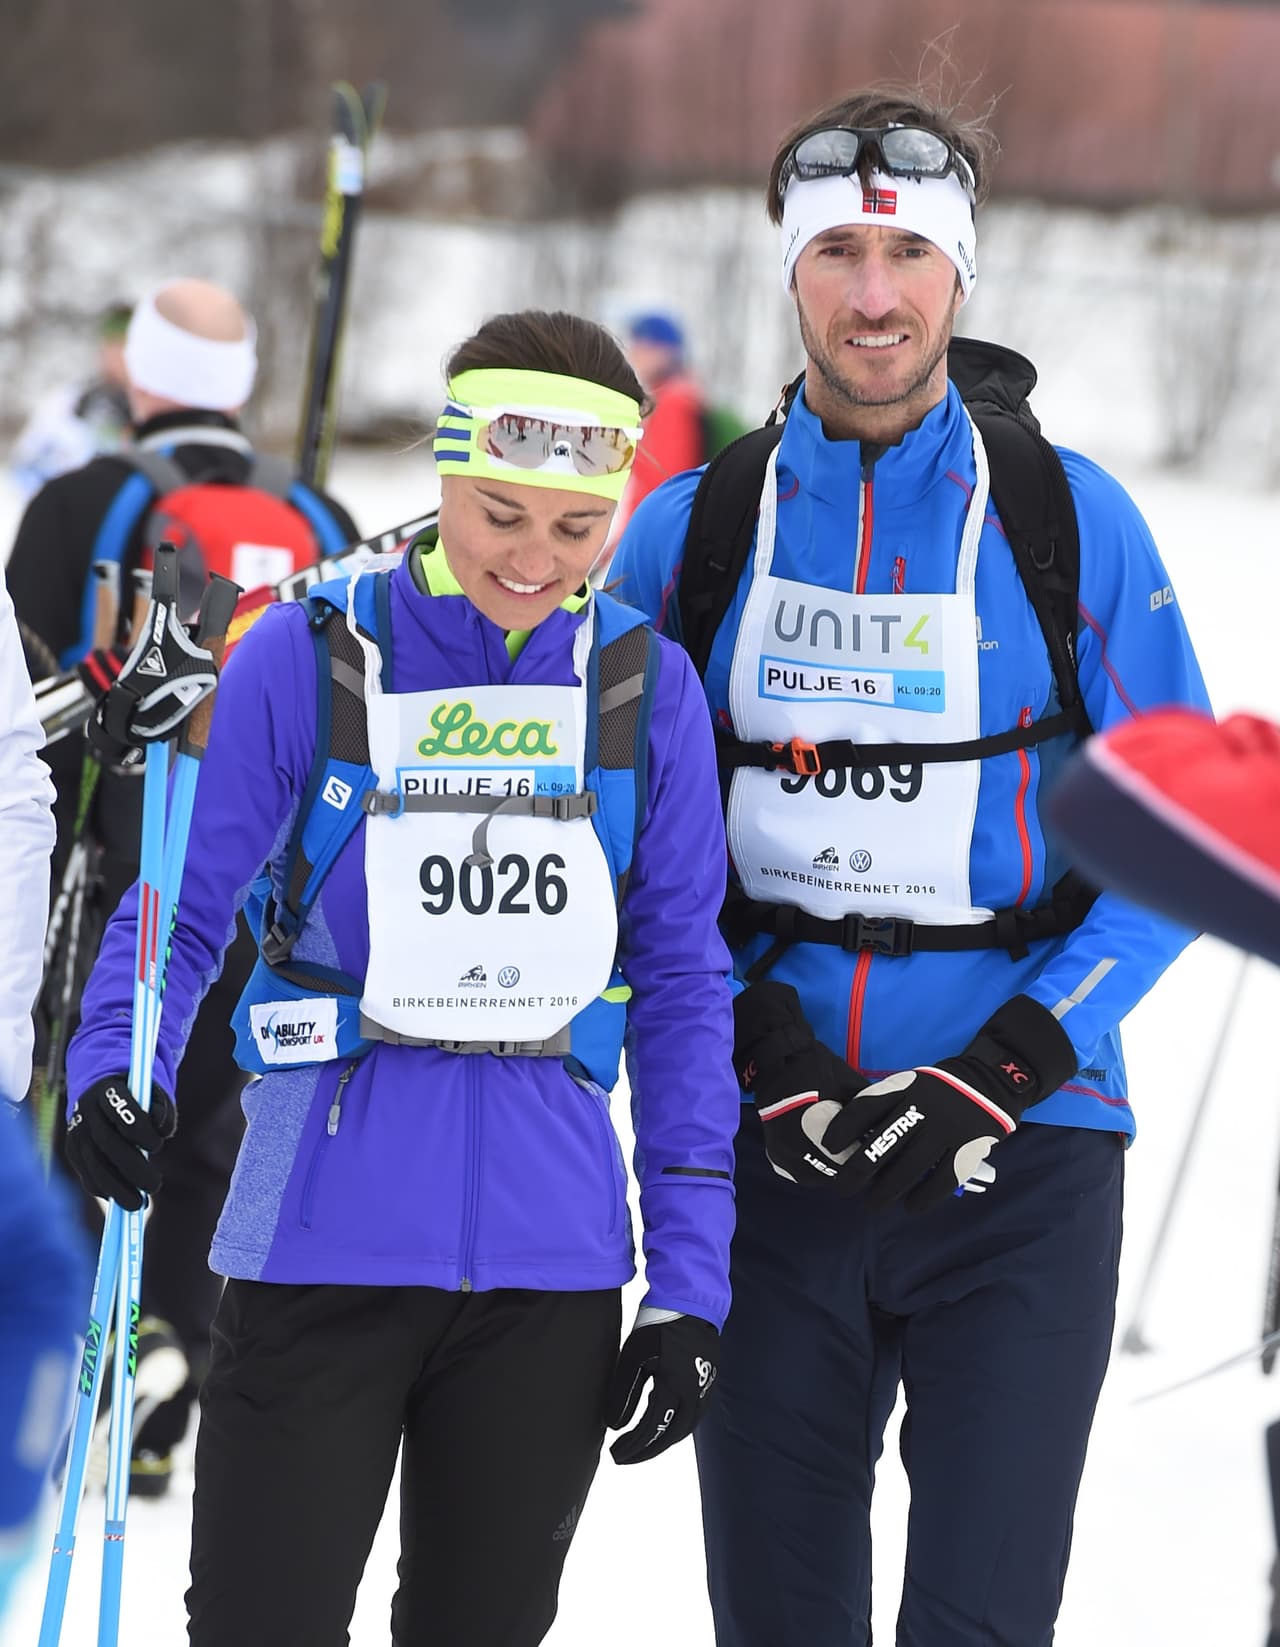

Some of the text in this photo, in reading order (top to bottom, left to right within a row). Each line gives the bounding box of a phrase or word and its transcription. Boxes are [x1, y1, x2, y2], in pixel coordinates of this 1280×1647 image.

[774, 600, 930, 655] UNIT4
[767, 668, 942, 697] PULJE 16 KL 09:20
[416, 701, 560, 758] Leca
[404, 777, 575, 797] PULJE 16 KL 09:20
[419, 853, 569, 916] 9026
[760, 867, 937, 896] BIRKEBEINERRENNET 2016
[392, 996, 579, 1009] BIRKEBEINERRENNET 2016
[1000, 1062, 1029, 1085] XC
[864, 1108, 926, 1164] HESTRA
